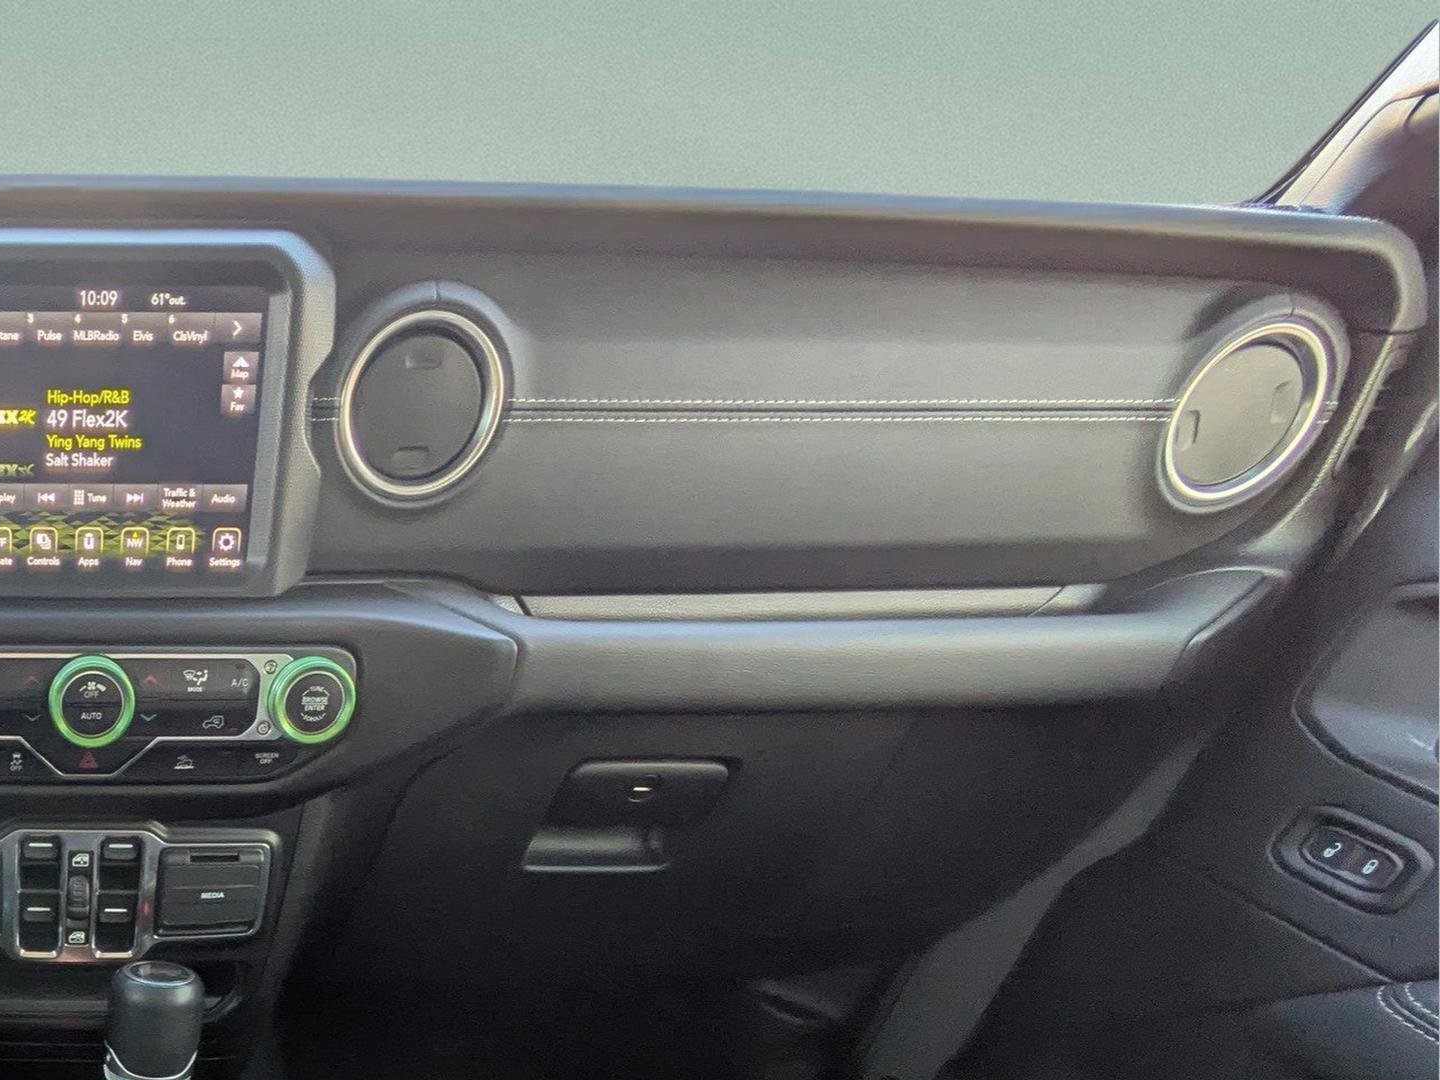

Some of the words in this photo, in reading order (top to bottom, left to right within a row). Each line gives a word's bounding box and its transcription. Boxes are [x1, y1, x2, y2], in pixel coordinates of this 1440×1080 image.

[79, 291, 118, 306] 10:09
[37, 330, 62, 341] Pulse
[132, 330, 154, 341] Elvis
[231, 370, 249, 380] Map
[47, 389, 130, 407] Hip-Hop/R&B
[46, 410, 68, 428] 49
[72, 410, 129, 428] Flex2K
[46, 434, 74, 450] Ying
[76, 434, 105, 450] Yang
[107, 434, 142, 449] Twins
[45, 453, 69, 467] Salt
[71, 453, 114, 467] Shaker
[87, 493, 107, 503] Tune
[211, 493, 236, 504] Audio
[26, 556, 60, 567] Controls
[78, 556, 99, 568] Apps
[125, 556, 142, 567] Nav
[166, 556, 192, 567] Phone
[209, 556, 240, 568] Settings
[231, 679, 249, 688] A/C
[80, 712, 102, 721] AUTO
